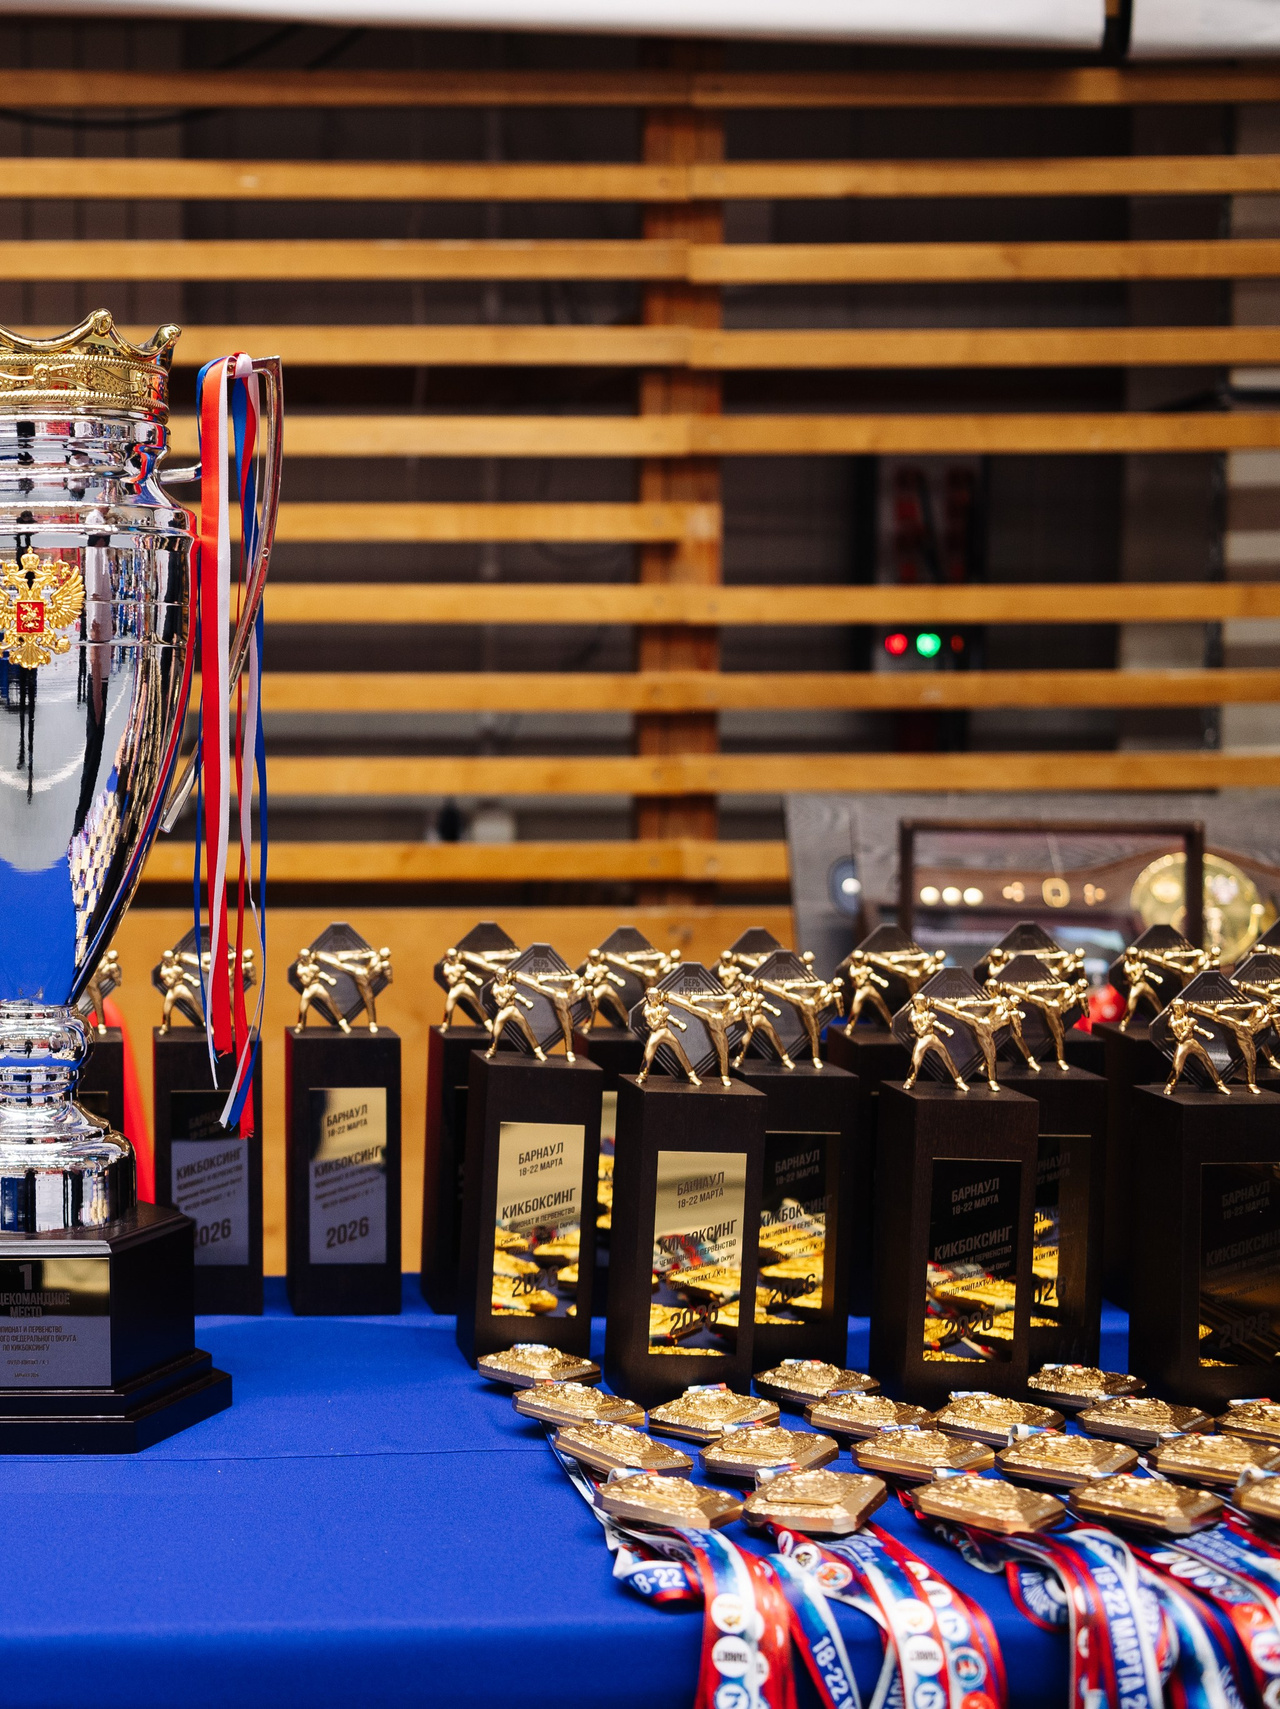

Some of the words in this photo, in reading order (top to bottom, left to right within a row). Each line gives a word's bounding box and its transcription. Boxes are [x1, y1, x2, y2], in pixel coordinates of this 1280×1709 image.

[533, 959, 548, 967] ВЕРЬ
[326, 1104, 368, 1127] БАРНАУЛ
[327, 1124, 345, 1138] 18-22
[347, 1118, 368, 1131] МАРТА
[177, 1147, 242, 1180] КИКБОКСИНГ
[315, 1146, 381, 1178] КИКБОКСИНГ
[518, 1142, 563, 1165] БАРНАУЛ
[519, 1163, 539, 1177] 18-22
[540, 1157, 563, 1171] МАРТА
[775, 1149, 819, 1174] БАРНАУЛ
[677, 1172, 725, 1196] БАРНАУЛ
[796, 1165, 819, 1180] МАРТА
[502, 1187, 576, 1220] КИКБОКСИНГ
[677, 1195, 698, 1209] 18-22
[699, 1187, 724, 1202] МАРТА
[952, 1178, 1000, 1203] БАРНАУЛ
[1222, 1180, 1270, 1208] БАРНАУЛ
[540, 1207, 575, 1222] ПЕРВЕНСТВО
[760, 1195, 833, 1227] КИКБОКСИНГ
[952, 1202, 973, 1216] 18-22
[974, 1194, 999, 1209] МАРТА
[1245, 1197, 1270, 1214] МАРТА
[326, 1216, 369, 1249] 2026
[660, 1219, 737, 1255] КИКБОКСИНГ
[934, 1226, 1012, 1262] КИКБОКСИНГ
[19, 1264, 32, 1290] 1
[512, 1265, 559, 1298] 2026
[10, 1306, 42, 1318] МЕСТО
[670, 1301, 719, 1335] 2026
[944, 1310, 994, 1343] 2026
[1219, 1311, 1271, 1349] 2026
[1091, 1566, 1131, 1617] 18-22
[812, 1636, 849, 1700] 18-22
[1110, 1617, 1145, 1694] МАРТА
